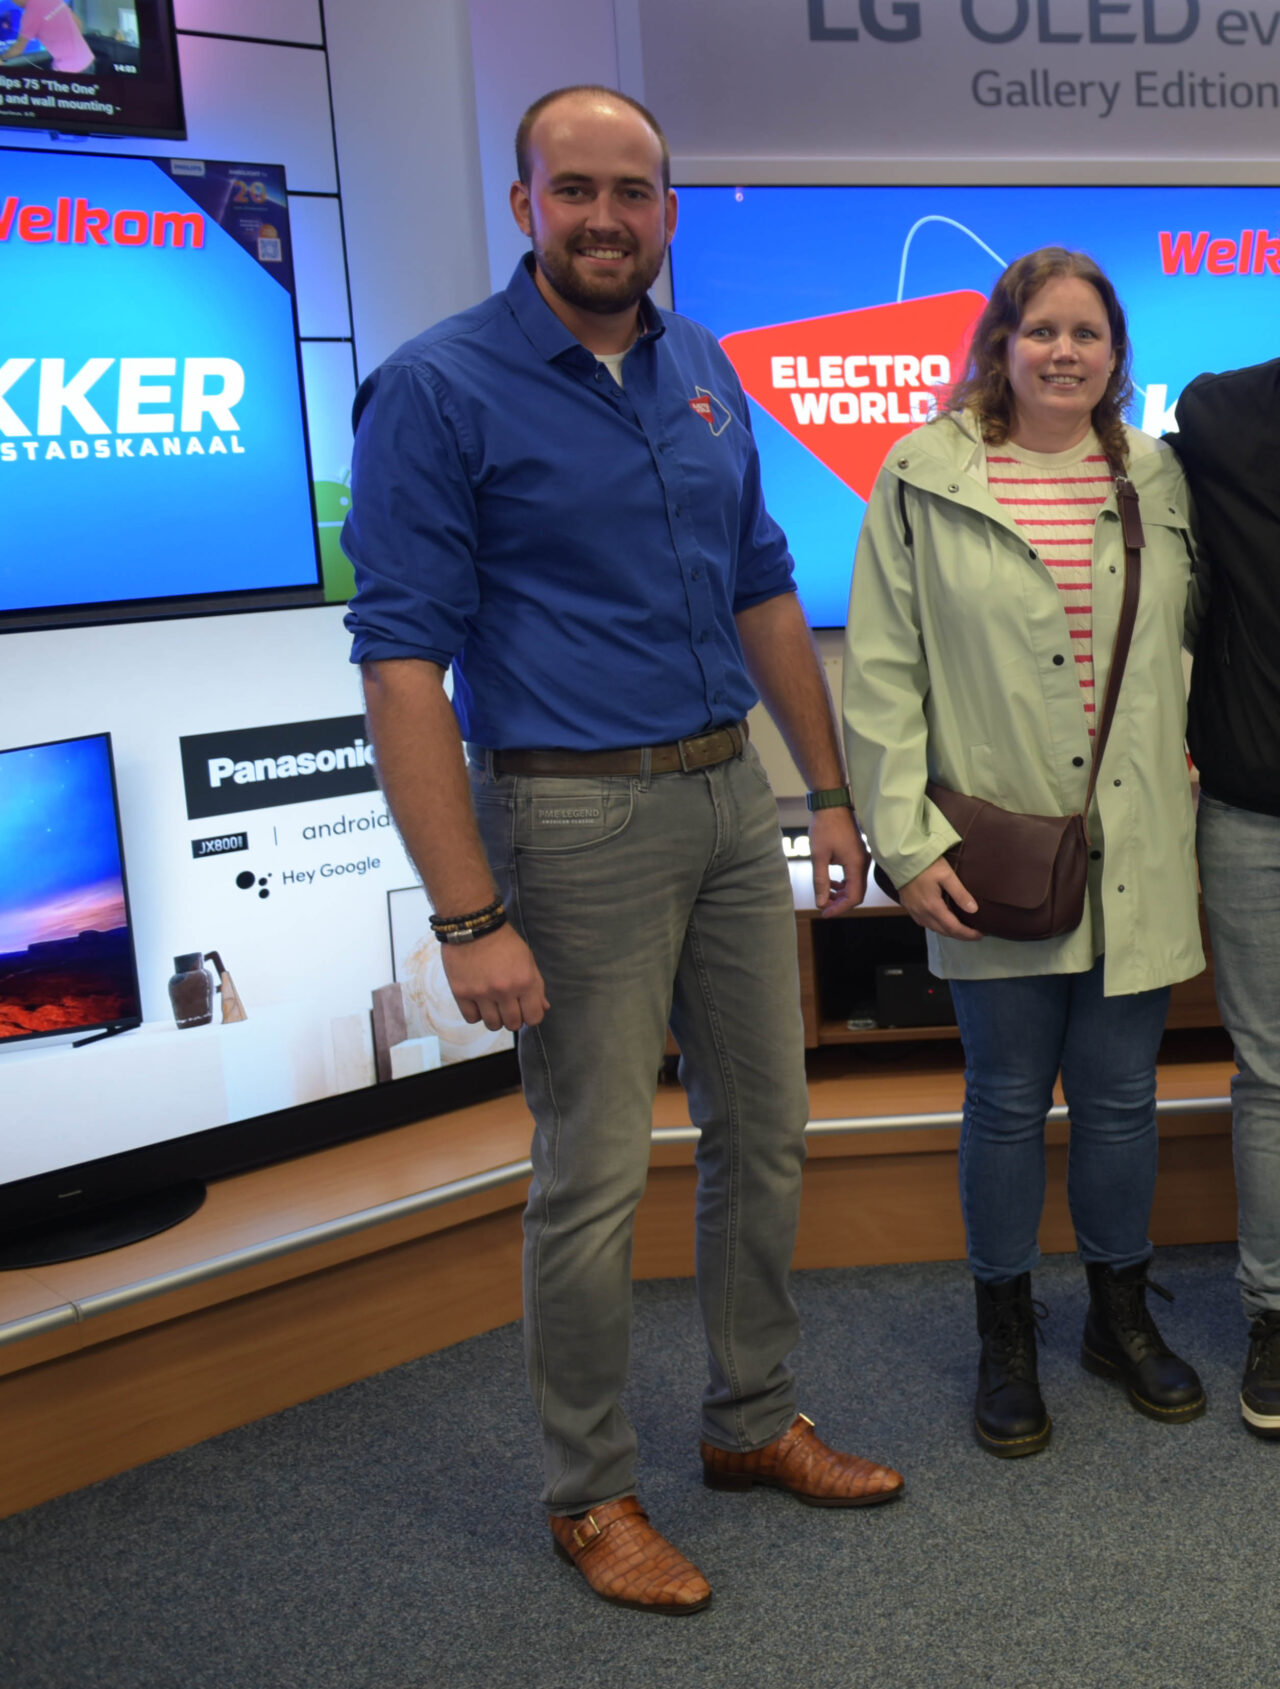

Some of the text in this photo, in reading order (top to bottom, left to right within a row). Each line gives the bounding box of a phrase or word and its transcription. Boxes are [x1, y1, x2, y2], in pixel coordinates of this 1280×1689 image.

[808, 0, 922, 43] LG
[961, 0, 1199, 45] OLED
[22, 77, 41, 91] 75
[971, 69, 1280, 118] Gallery Edition
[30, 96, 57, 107] wall
[57, 98, 114, 116] mounting
[770, 354, 951, 389] ELECTRO
[790, 391, 938, 425] WORLD
[0, 435, 246, 462] STADSKANAAL
[302, 810, 391, 841] android
[562, 808, 600, 818] LEGEND
[282, 856, 381, 885] Hey Google
